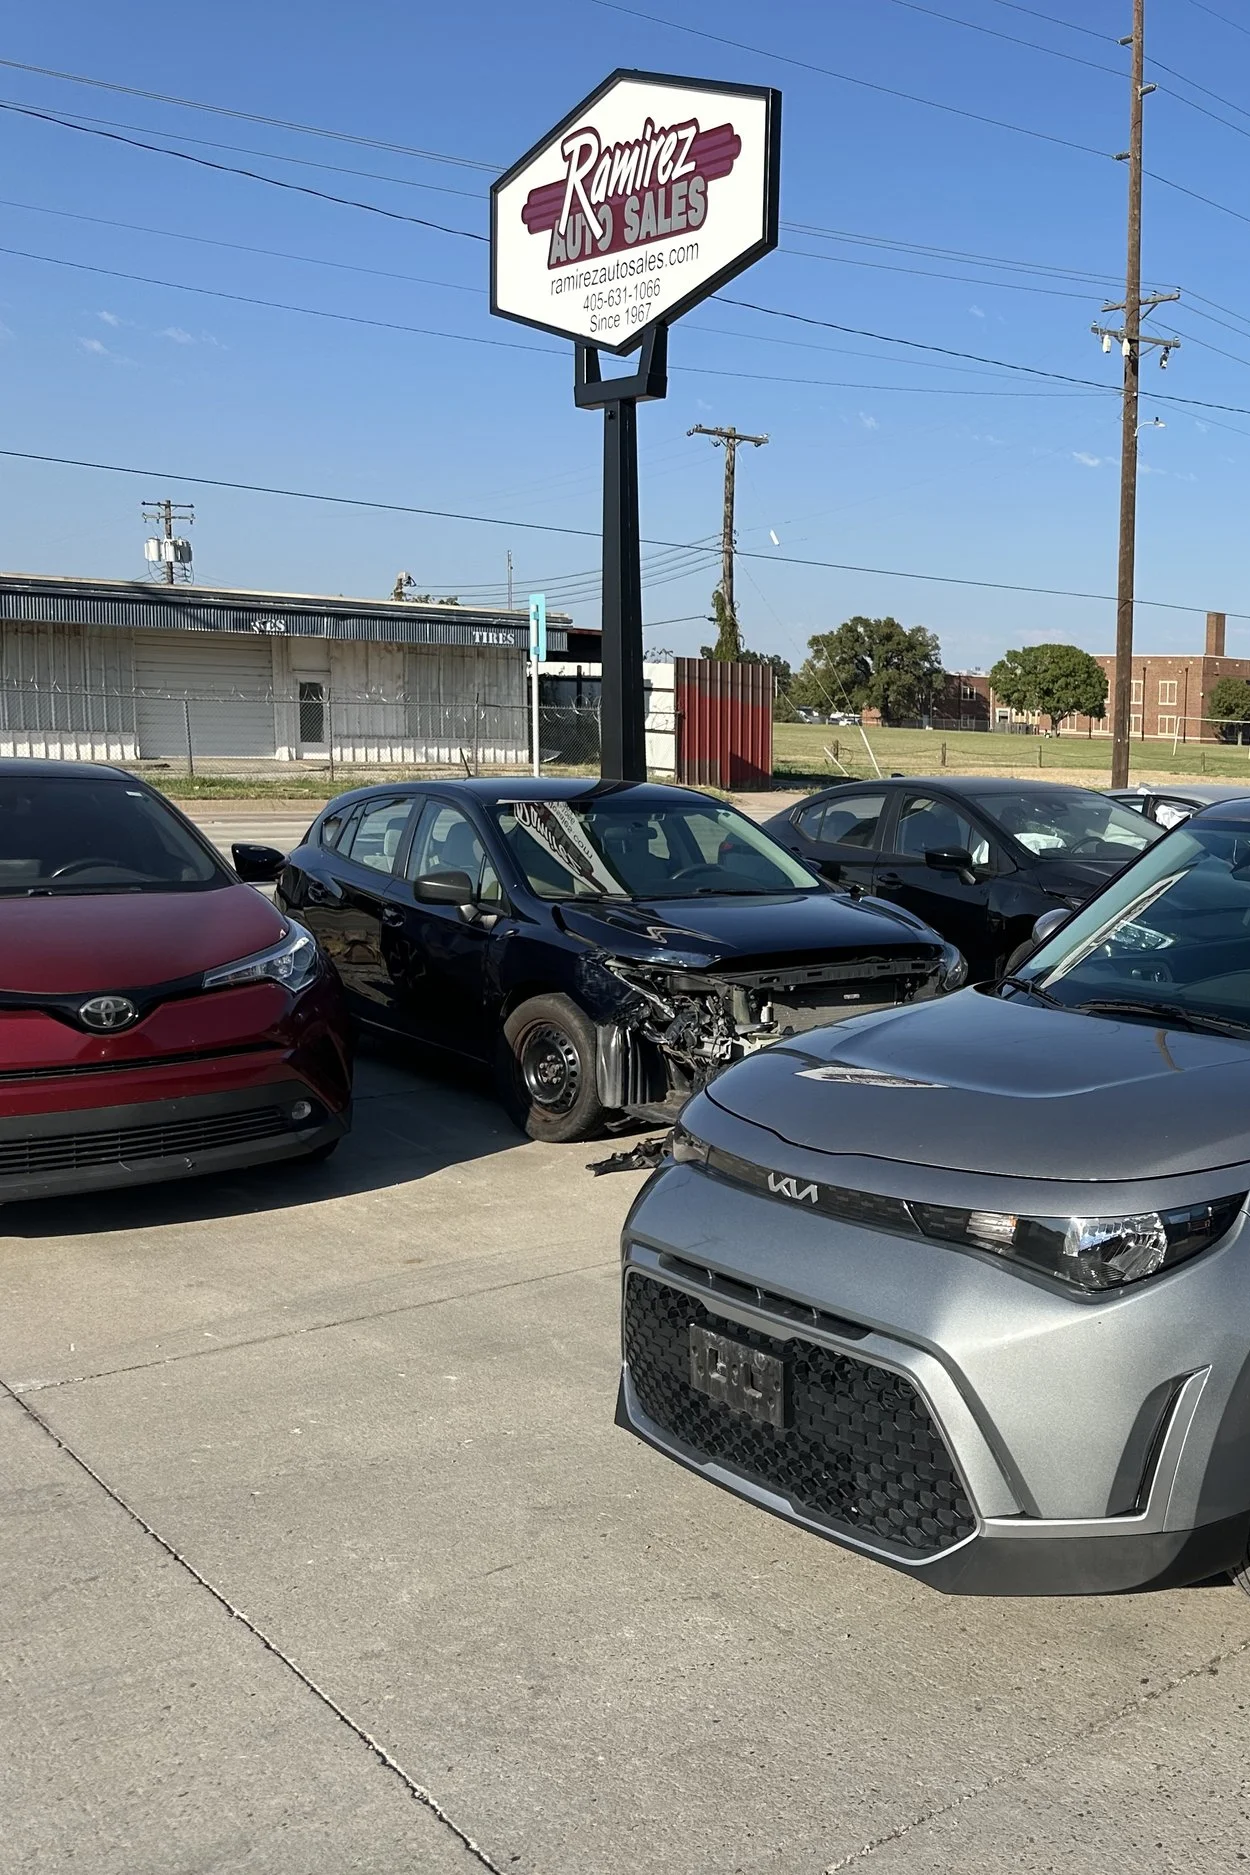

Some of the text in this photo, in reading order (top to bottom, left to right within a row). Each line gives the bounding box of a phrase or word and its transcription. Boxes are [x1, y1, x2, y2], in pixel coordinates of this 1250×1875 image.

[562, 121, 699, 240] Ramirez
[550, 175, 705, 265] AUTO SALES
[551, 242, 699, 296] ramirezautosales.com
[583, 278, 661, 312] 405-631-1066
[589, 302, 652, 333] Since 1967
[472, 631, 515, 645] TIRES
[767, 1172, 819, 1204] KIA
